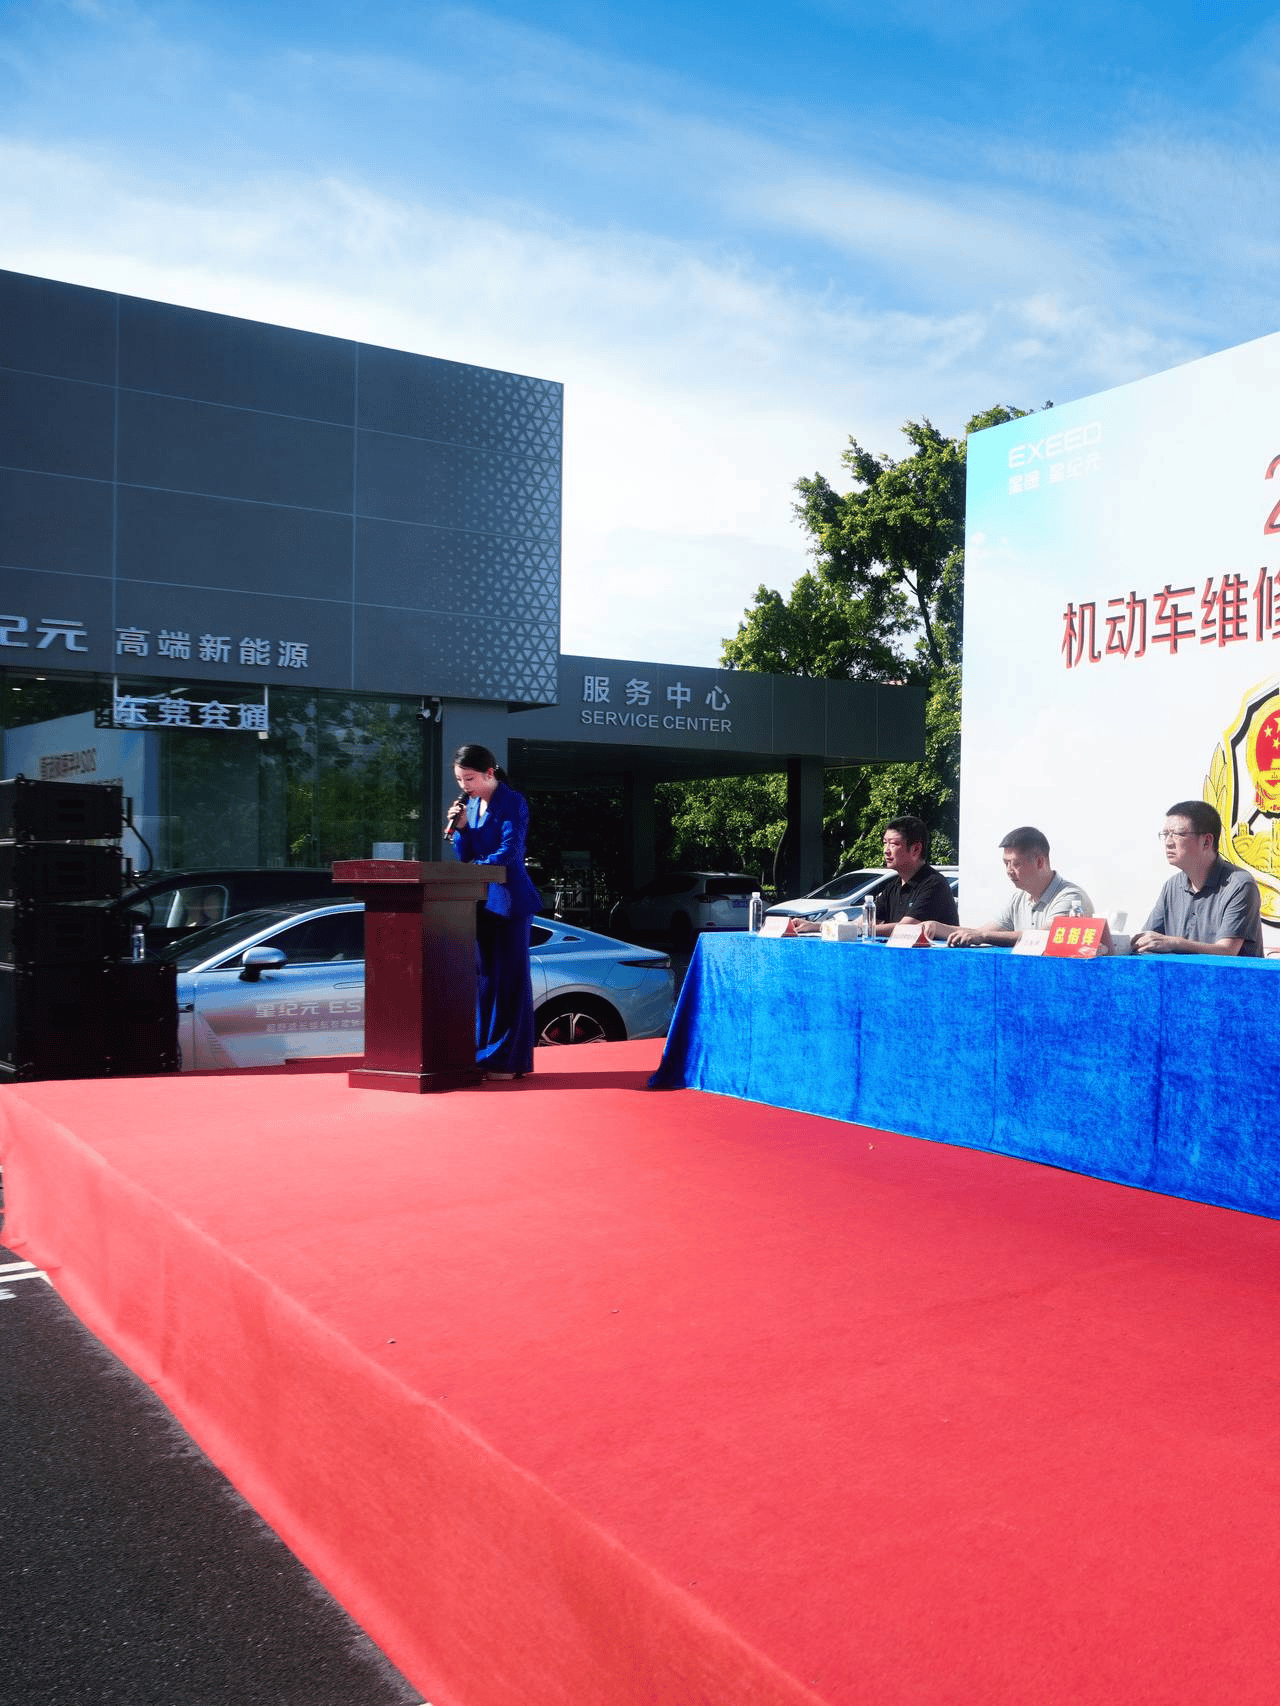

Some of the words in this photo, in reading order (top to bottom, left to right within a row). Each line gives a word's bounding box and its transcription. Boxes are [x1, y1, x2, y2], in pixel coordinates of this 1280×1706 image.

[1007, 421, 1102, 469] EXEED
[115, 627, 310, 668] 高端新能源
[582, 675, 732, 712] 服务中心
[115, 695, 269, 731] 东莞会通
[581, 710, 660, 729] SERVICE
[663, 715, 732, 733] CENTER
[1053, 927, 1097, 945] 总指挥
